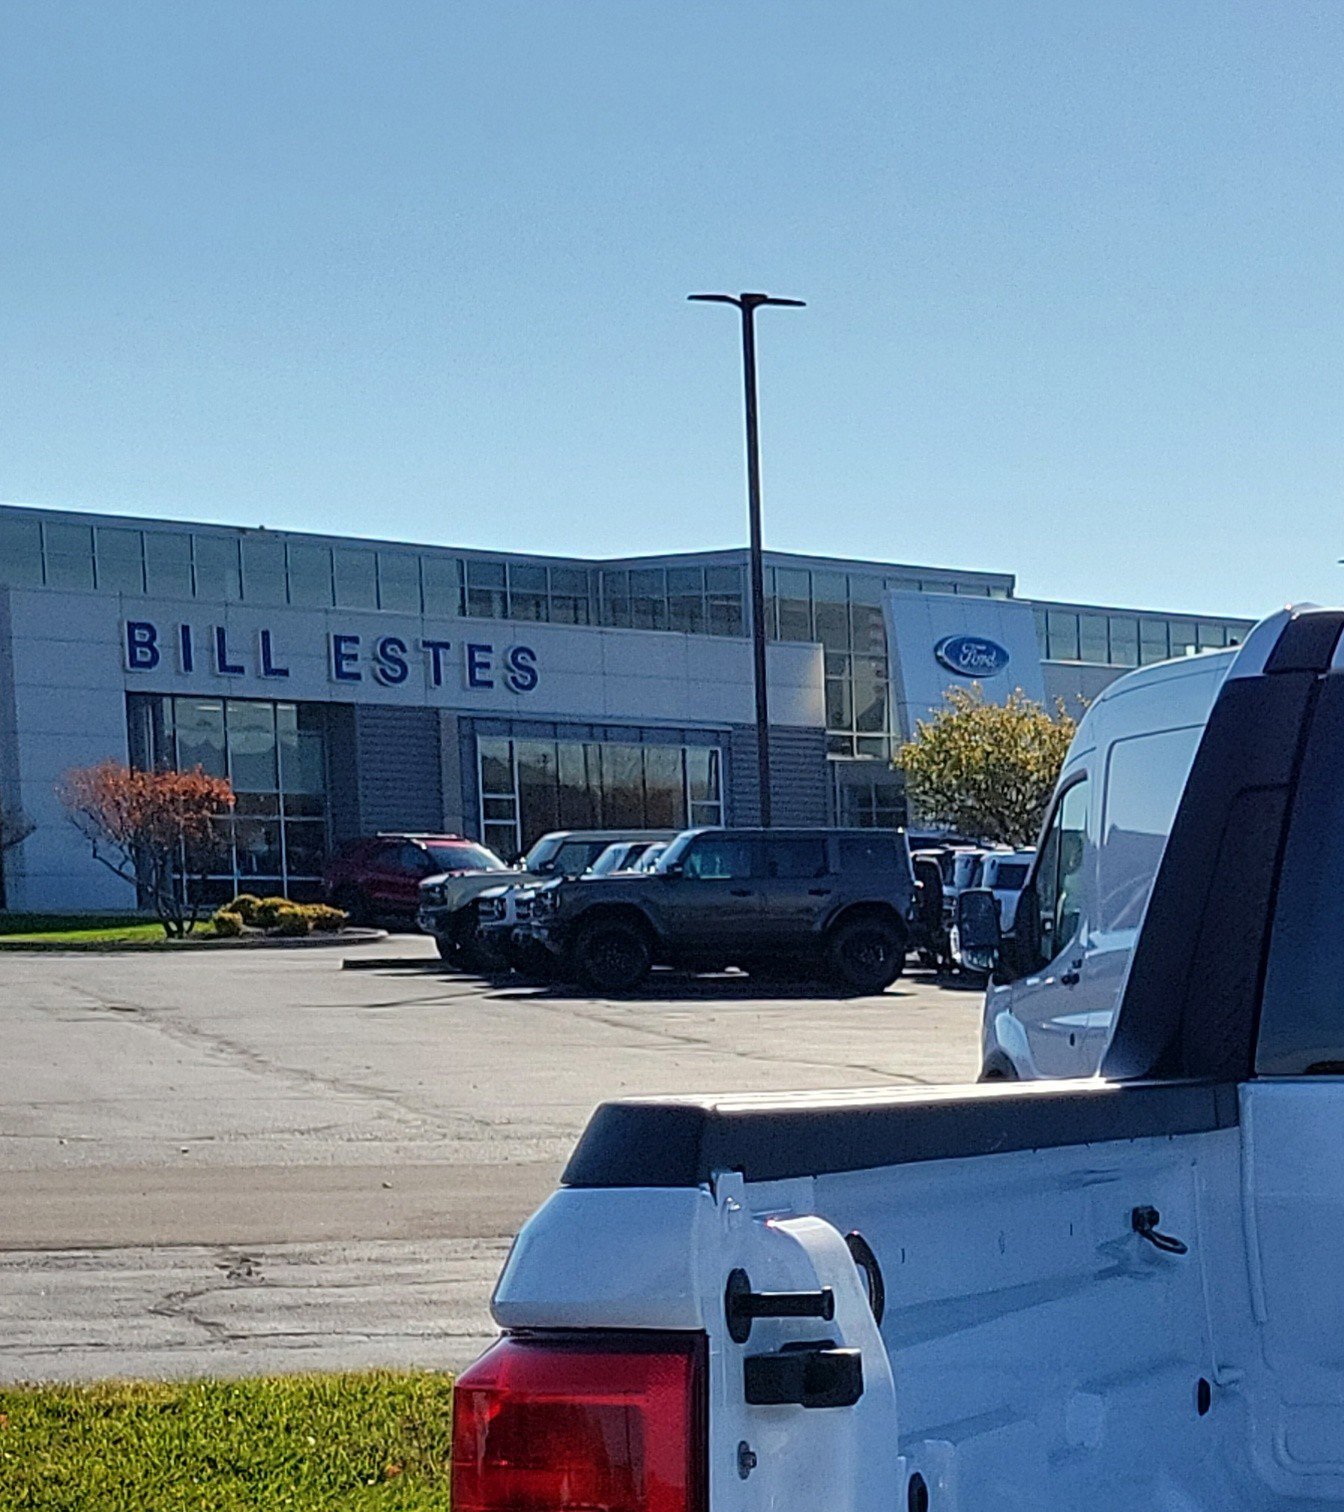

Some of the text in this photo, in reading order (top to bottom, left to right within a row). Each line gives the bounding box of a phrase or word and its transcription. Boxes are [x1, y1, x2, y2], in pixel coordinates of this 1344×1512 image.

[126, 620, 540, 693] BILL ESTES
[959, 643, 997, 668] Ford
